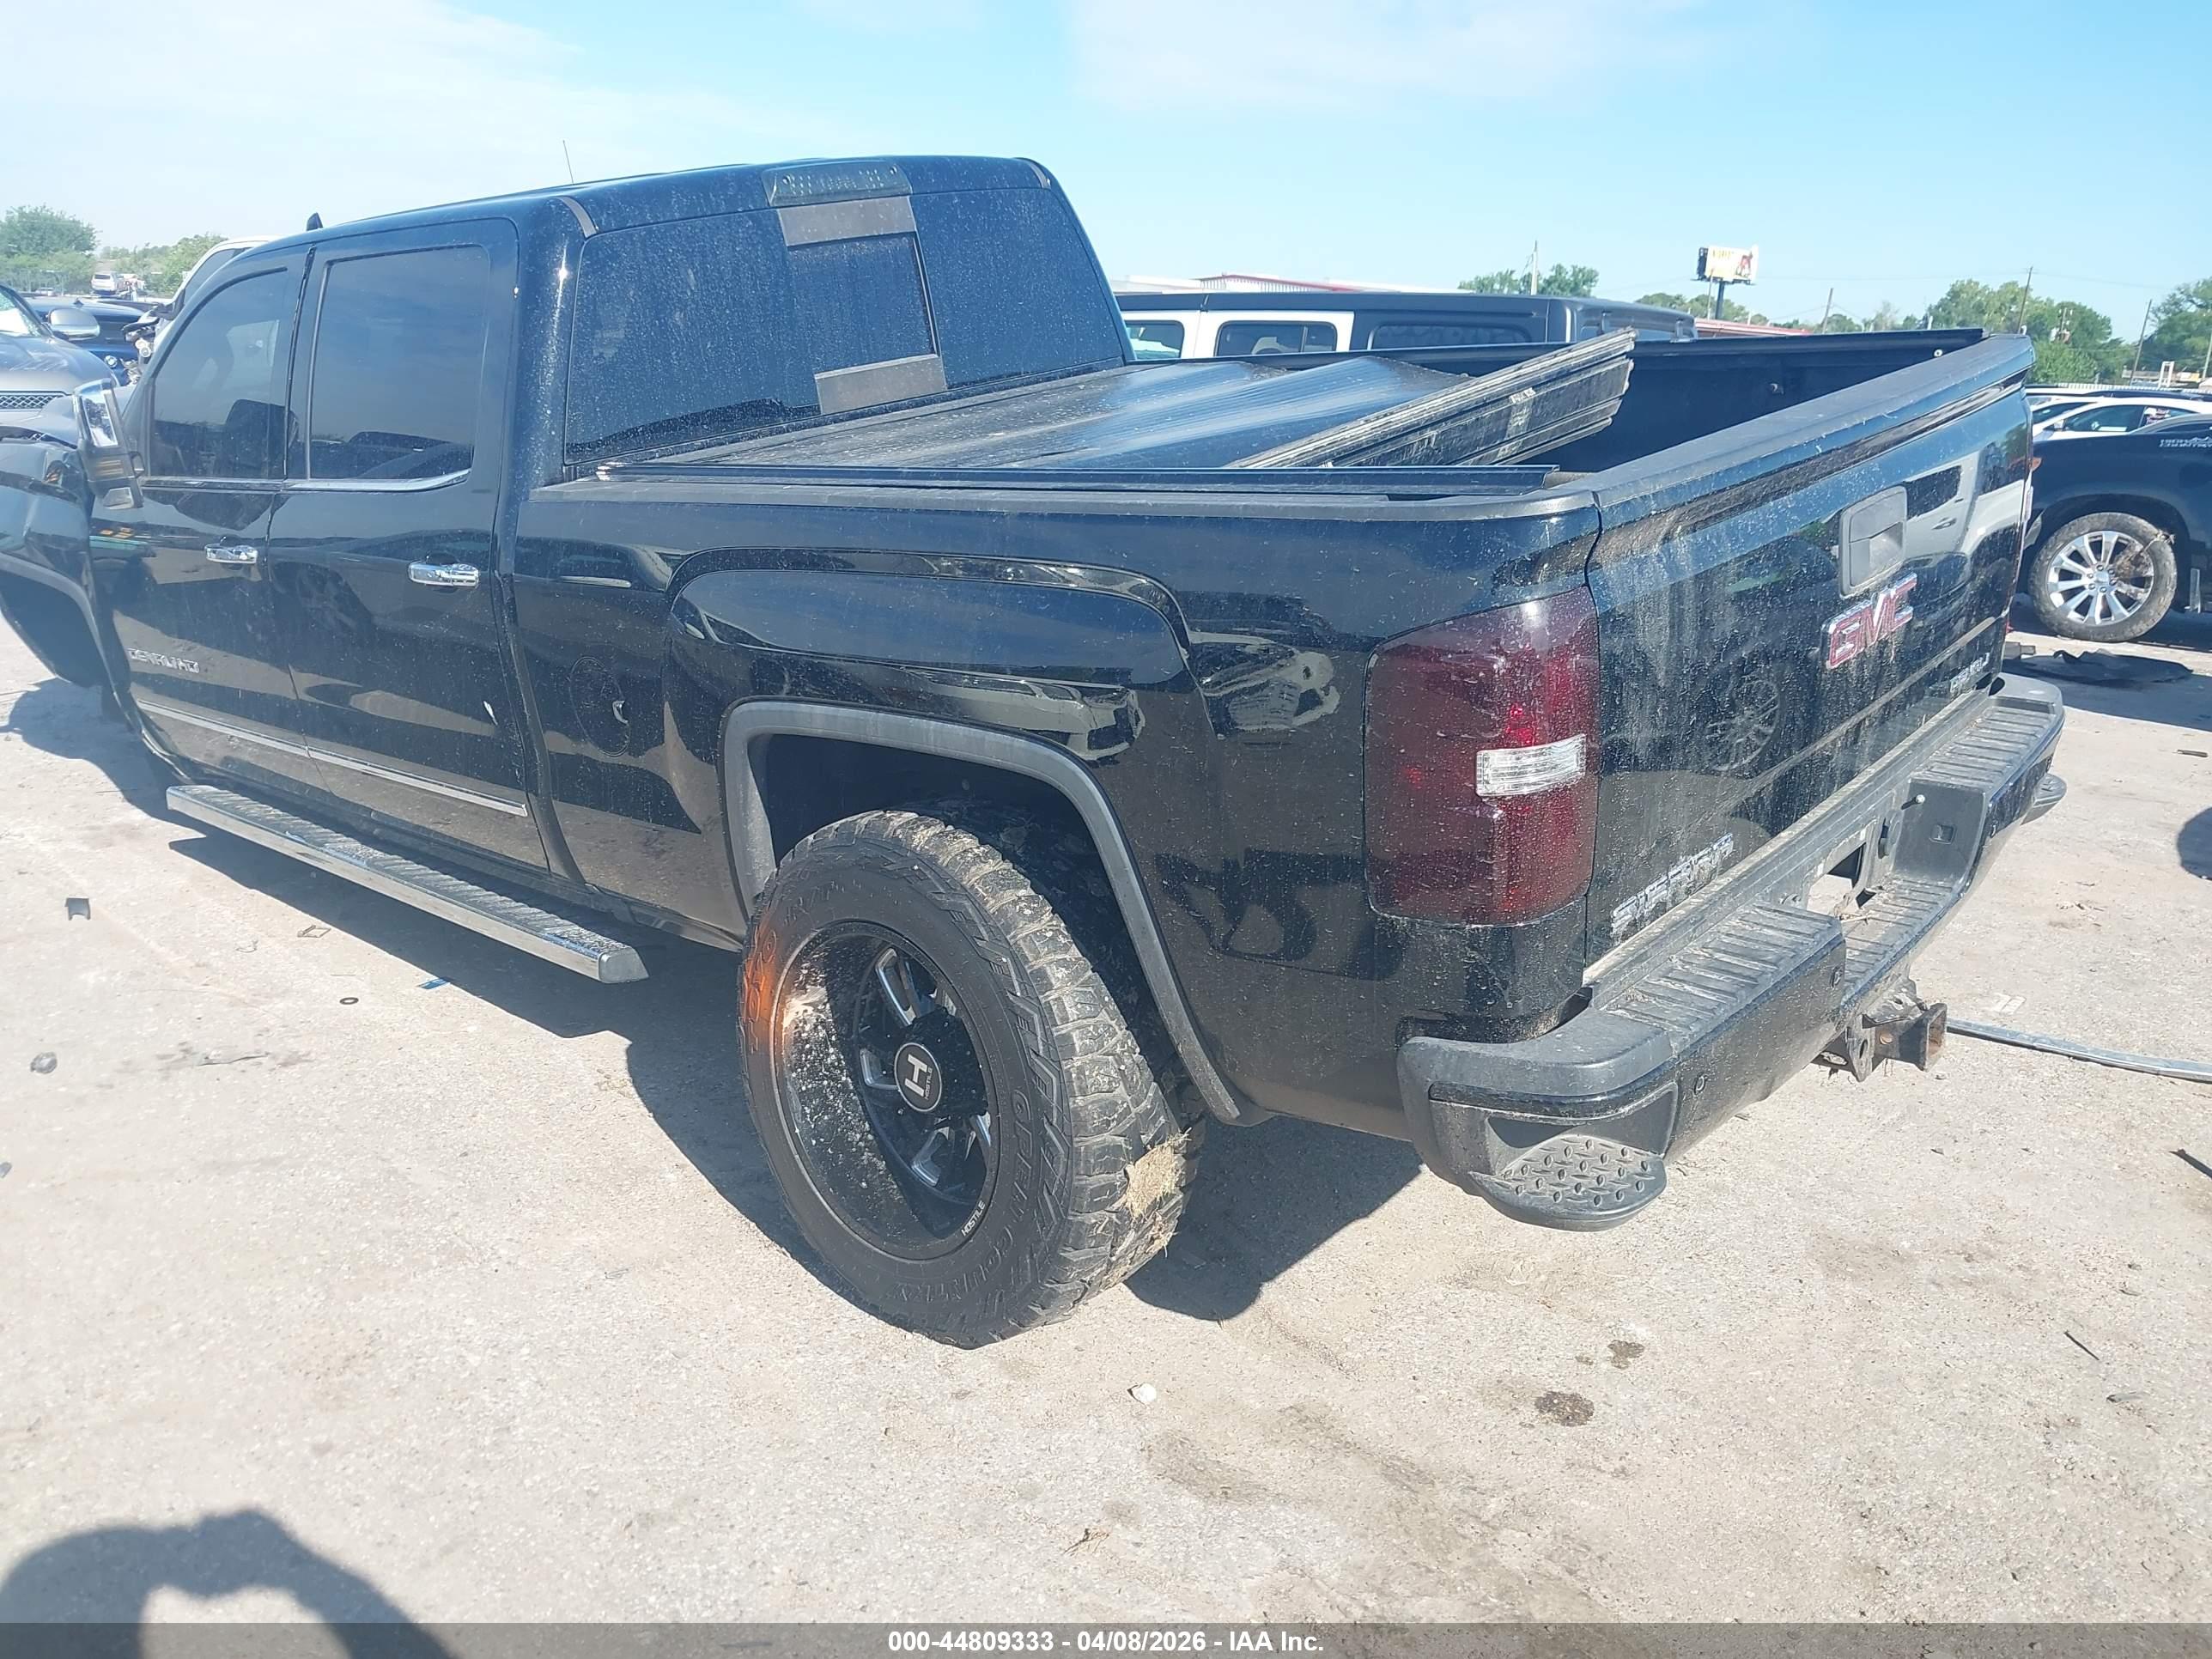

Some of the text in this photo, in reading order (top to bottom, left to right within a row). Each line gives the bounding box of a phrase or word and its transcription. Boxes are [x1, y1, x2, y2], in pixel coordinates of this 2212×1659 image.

[1826, 573, 1917, 669] GMC
[924, 1066, 933, 1100] HOSTILE
[961, 1200, 986, 1237] HOSTILE
